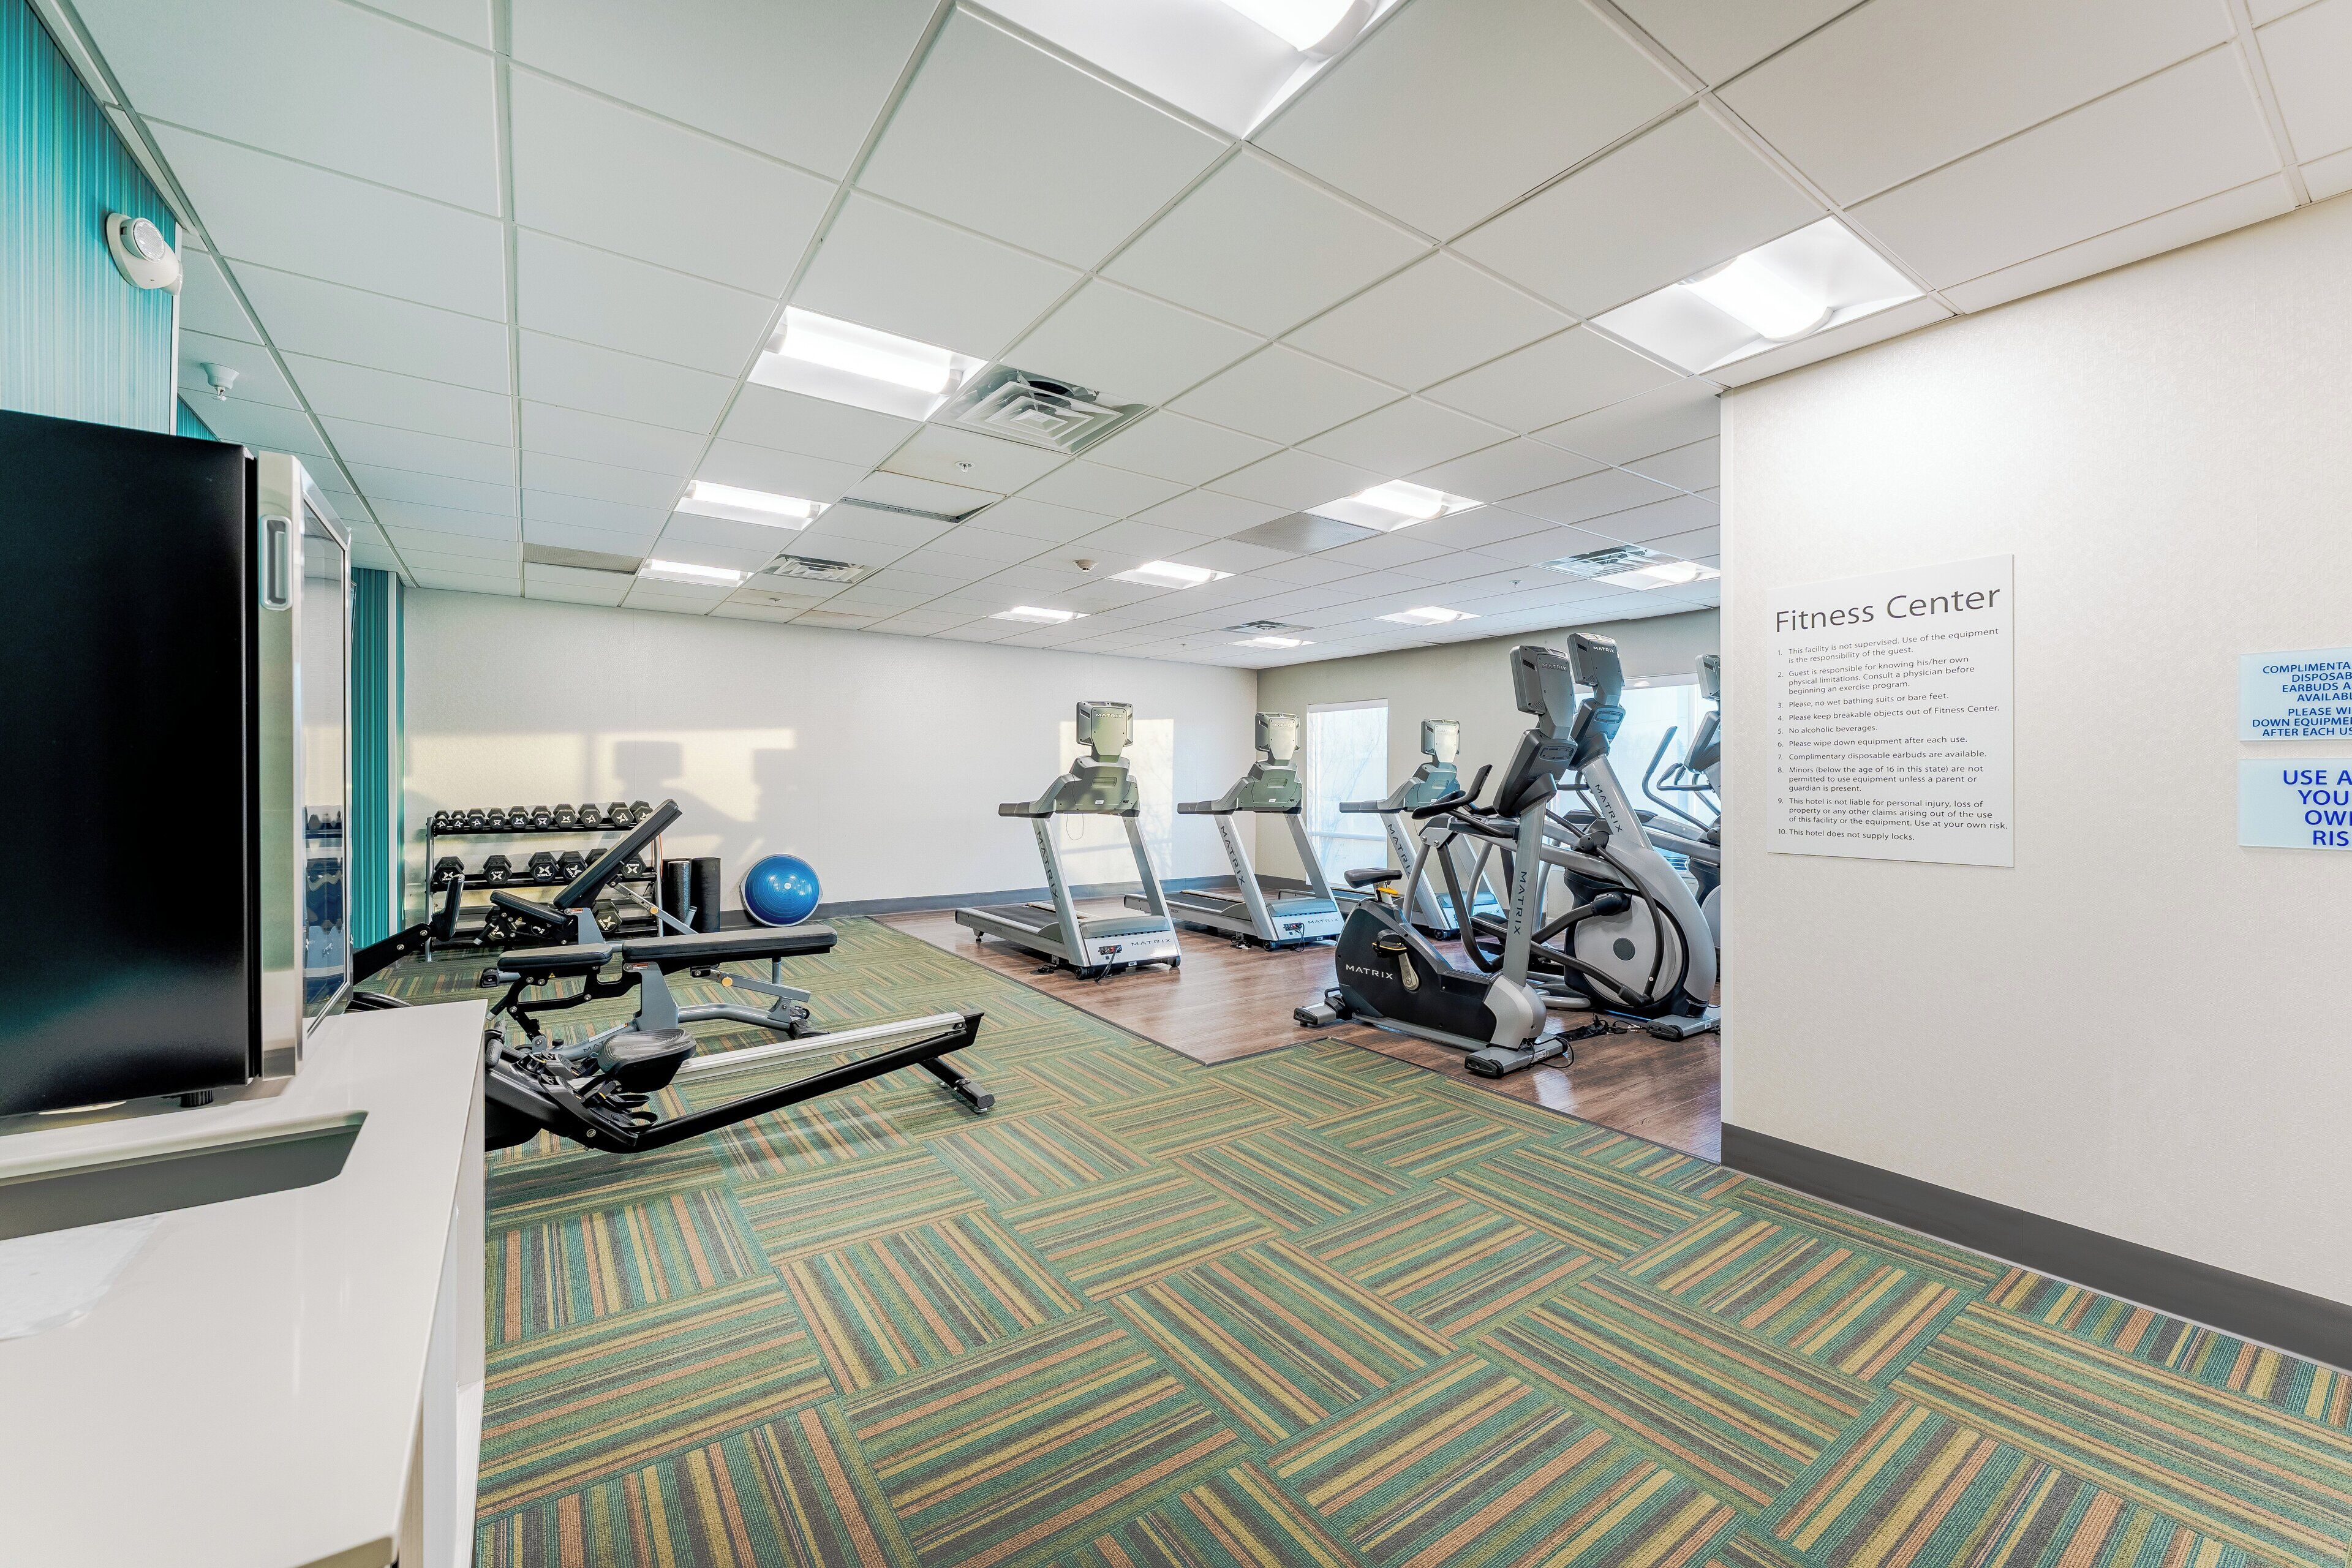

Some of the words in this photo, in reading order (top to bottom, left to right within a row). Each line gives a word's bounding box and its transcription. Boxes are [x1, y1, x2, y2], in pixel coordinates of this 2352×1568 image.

[1776, 605, 1874, 633] Fitness
[1886, 588, 2000, 619] Center
[1855, 638, 1900, 649] supervised.
[1948, 628, 1999, 640] equipment
[1810, 652, 1860, 662] responsibility
[1888, 647, 1913, 657] guest.
[1542, 663, 1567, 672] MATRIX
[1819, 665, 1863, 674] responsible
[1879, 661, 1914, 669] knowing
[1789, 677, 1817, 687] physical
[1820, 674, 1861, 684] limitations.
[1863, 671, 1894, 680] Consult
[1903, 669, 1942, 679] physician
[1945, 666, 1975, 675] before
[1789, 687, 1826, 695] beginning
[1872, 682, 1910, 690] program.
[2282, 682, 2339, 693] EARBUDS
[1843, 697, 1873, 706] bathing
[1833, 710, 1871, 719] breakable
[2288, 707, 2332, 716] PLEASE
[2252, 718, 2290, 727] DOWN
[2294, 717, 2352, 727] EQUIPME
[2262, 728, 2299, 737] AFTER
[2303, 727, 2334, 736] EACH
[1858, 737, 1902, 747] equipment
[1848, 752, 1890, 760] disposable
[1893, 751, 1926, 760] earbuds
[1945, 750, 1987, 758] available.
[1843, 766, 1856, 774] the
[1925, 765, 1948, 774] state)
[2283, 769, 2328, 785] USE
[1595, 784, 1623, 832] MATRIX
[1925, 800, 1951, 809] injury,
[1973, 801, 1984, 809] of
[1813, 816, 1838, 825] facility
[1865, 818, 1912, 827] equipment.
[2304, 810, 2352, 826] OW
[1863, 832, 1890, 841] supply
[1220, 826, 1245, 886] MATRIX
[1037, 831, 1058, 900] MATRIX
[1513, 871, 1528, 935] MATRIX
[1346, 964, 1393, 980] MATRIX
[583, 1040, 605, 1052] MAT
